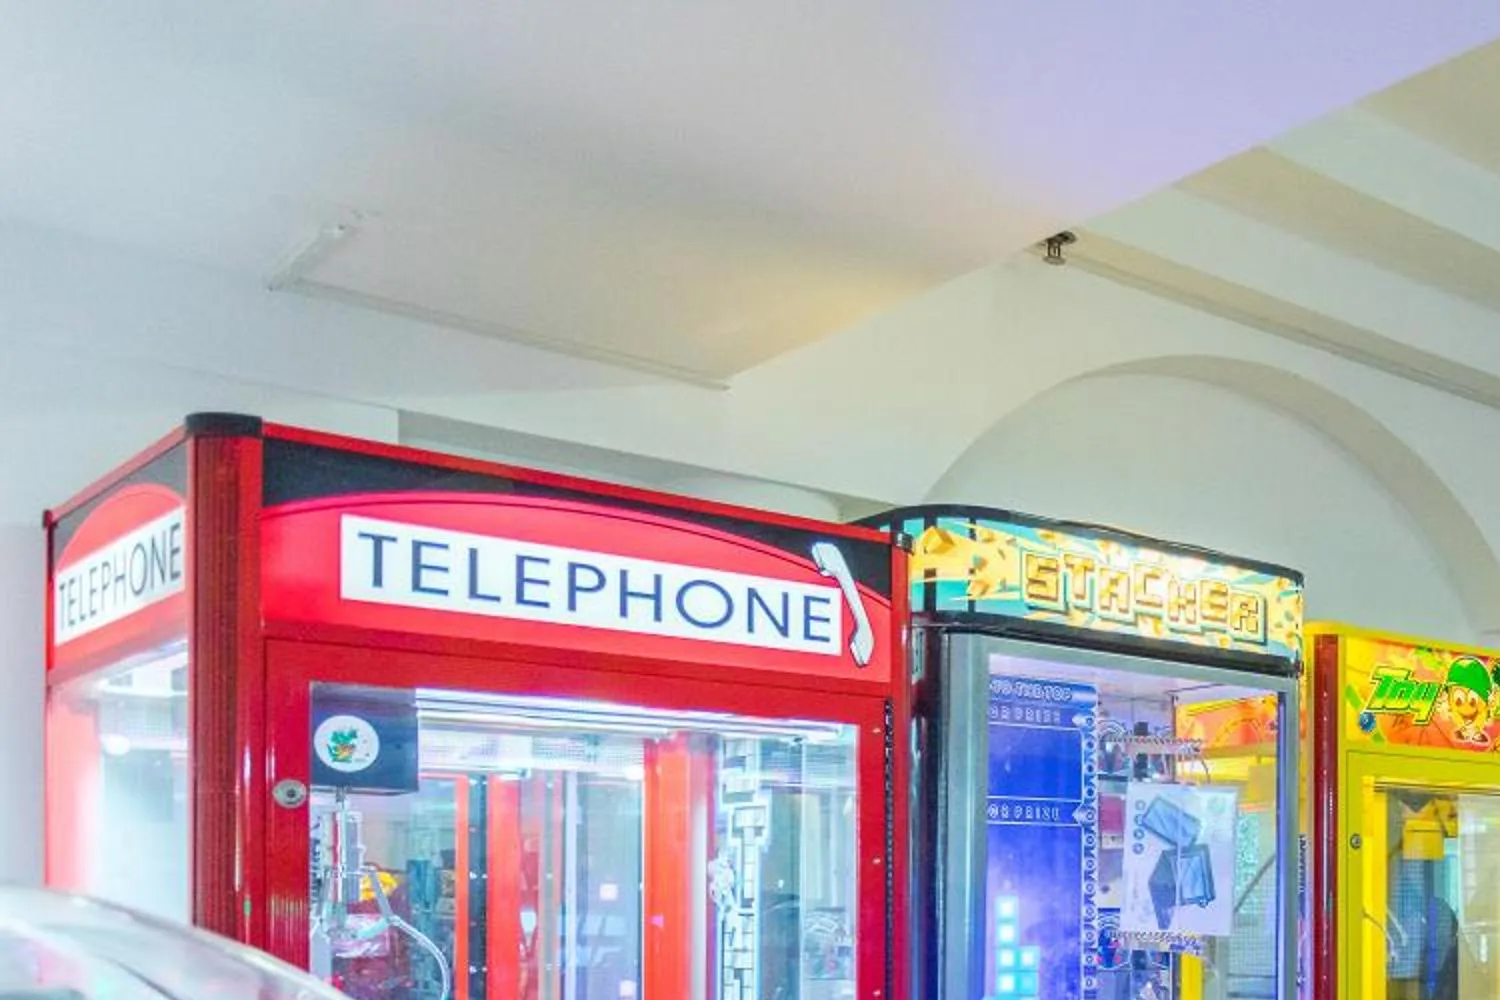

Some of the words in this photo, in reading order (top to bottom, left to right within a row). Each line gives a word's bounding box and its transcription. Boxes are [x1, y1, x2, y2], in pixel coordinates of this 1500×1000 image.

[59, 521, 181, 632] TELEPHONE
[358, 531, 833, 644] TELEPHONE
[1024, 551, 1263, 636] STACKER
[1369, 666, 1443, 725] Toy
